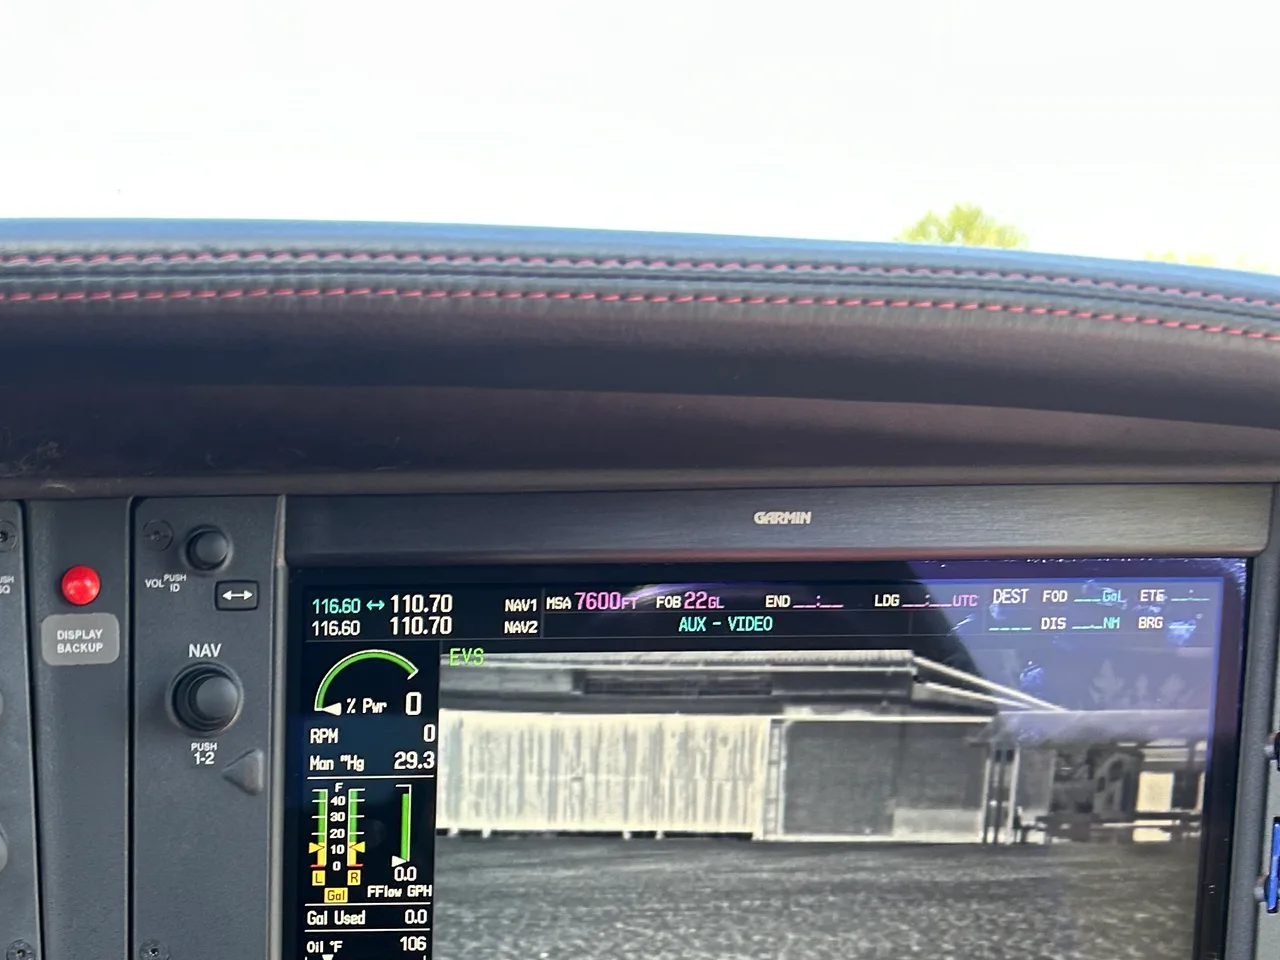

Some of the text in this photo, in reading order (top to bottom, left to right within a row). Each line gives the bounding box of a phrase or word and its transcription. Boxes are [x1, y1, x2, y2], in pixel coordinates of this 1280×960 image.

[753, 511, 812, 525] GARMIN
[312, 594, 538, 614] 116.60 110.70 NAV1
[546, 597, 572, 610] MSA
[993, 589, 1029, 605] DEST
[312, 616, 538, 636] 116.60 110.70 NAV2
[678, 616, 773, 632] AUX VIDEO
[57, 629, 103, 640] DISPLAY
[57, 642, 104, 654] BACKUP
[189, 644, 221, 658] NAV
[449, 648, 485, 666] EVS
[310, 728, 339, 743] RPM
[394, 751, 435, 769] 29.3
[367, 885, 432, 897] FFlow GPH
[306, 910, 366, 925] Gal Used
[400, 936, 427, 951] 106
